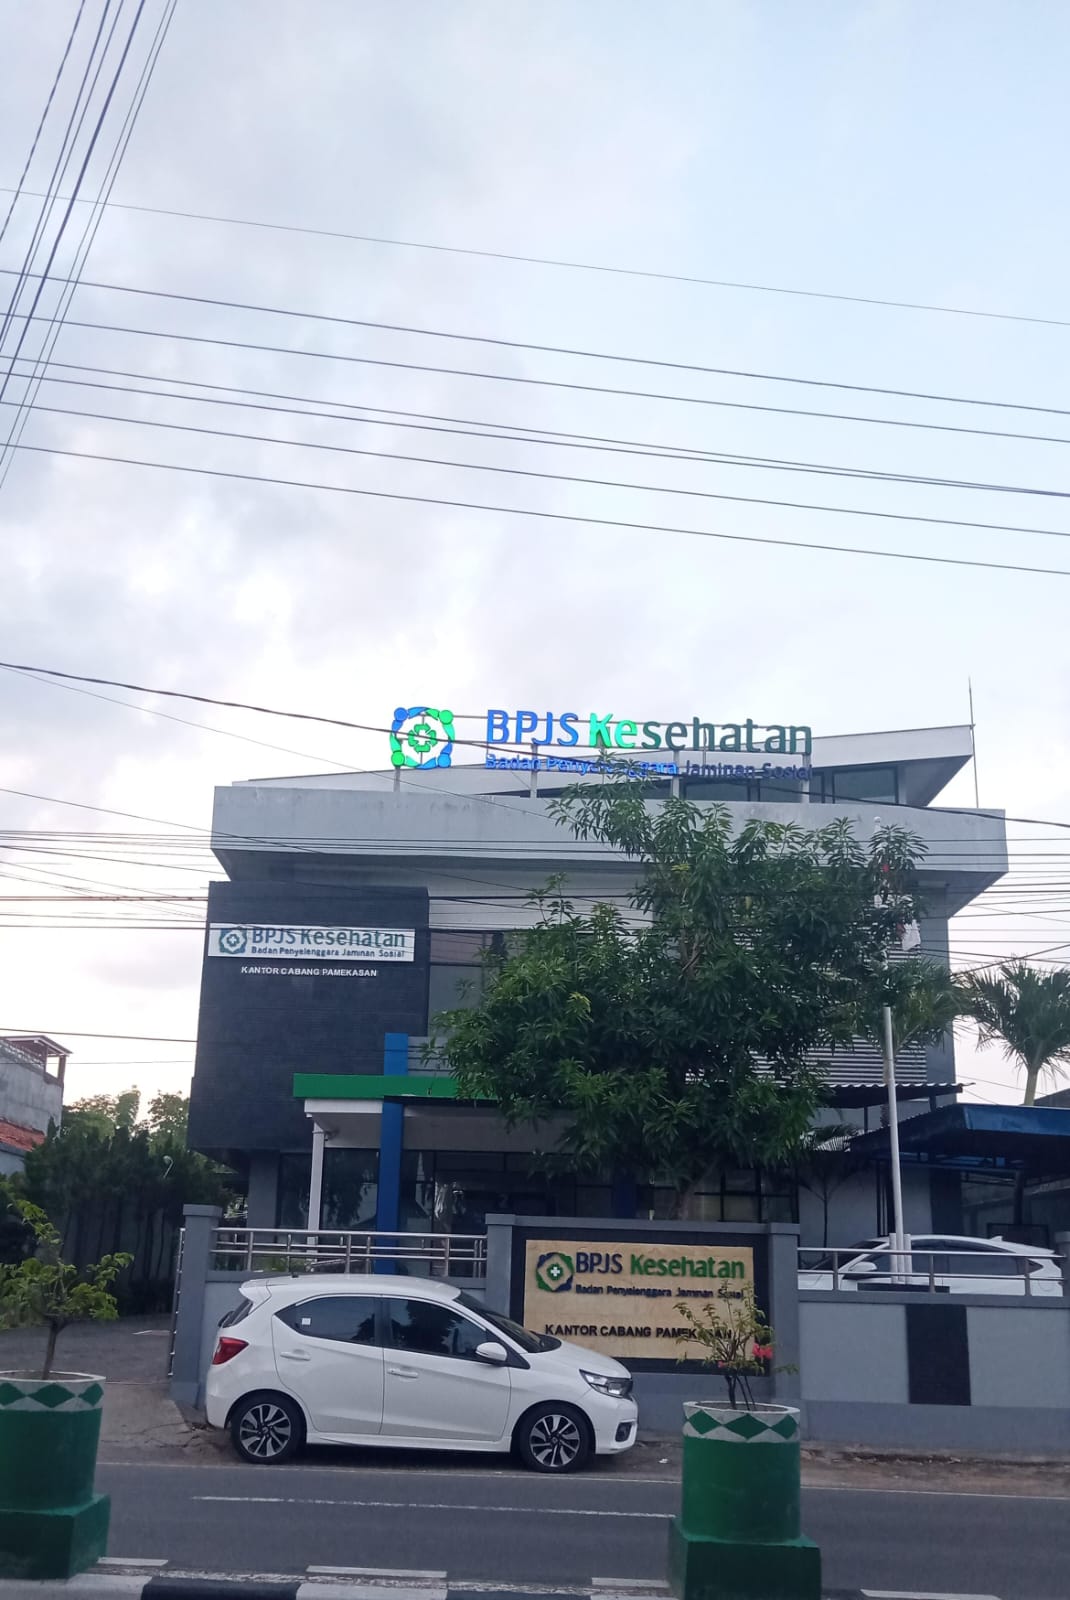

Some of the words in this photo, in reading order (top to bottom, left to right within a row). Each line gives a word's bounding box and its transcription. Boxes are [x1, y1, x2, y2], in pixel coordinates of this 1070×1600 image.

[486, 709, 580, 747] BPJS
[588, 712, 813, 755] Kesehatan
[485, 753, 541, 771] Badan
[762, 762, 813, 781] Sosial
[252, 927, 296, 944] BPJS
[300, 929, 405, 947] Kesehatan
[251, 946, 278, 954] Badan
[279, 947, 339, 957] Penyelenggara
[342, 949, 375, 957] Jaminan
[378, 949, 405, 957] Sosial
[241, 966, 280, 975] KANTOR
[280, 967, 320, 976] CABANG
[322, 967, 377, 977] PAMEKASAN
[575, 1252, 623, 1274] BPJS
[630, 1254, 745, 1279] Kesehatan
[575, 1284, 604, 1295] Badan
[606, 1285, 672, 1299] Penyelenggara
[545, 1324, 598, 1336] KANTOR
[599, 1325, 651, 1338] CABANG
[655, 1327, 733, 1340] PAMEKSAN
